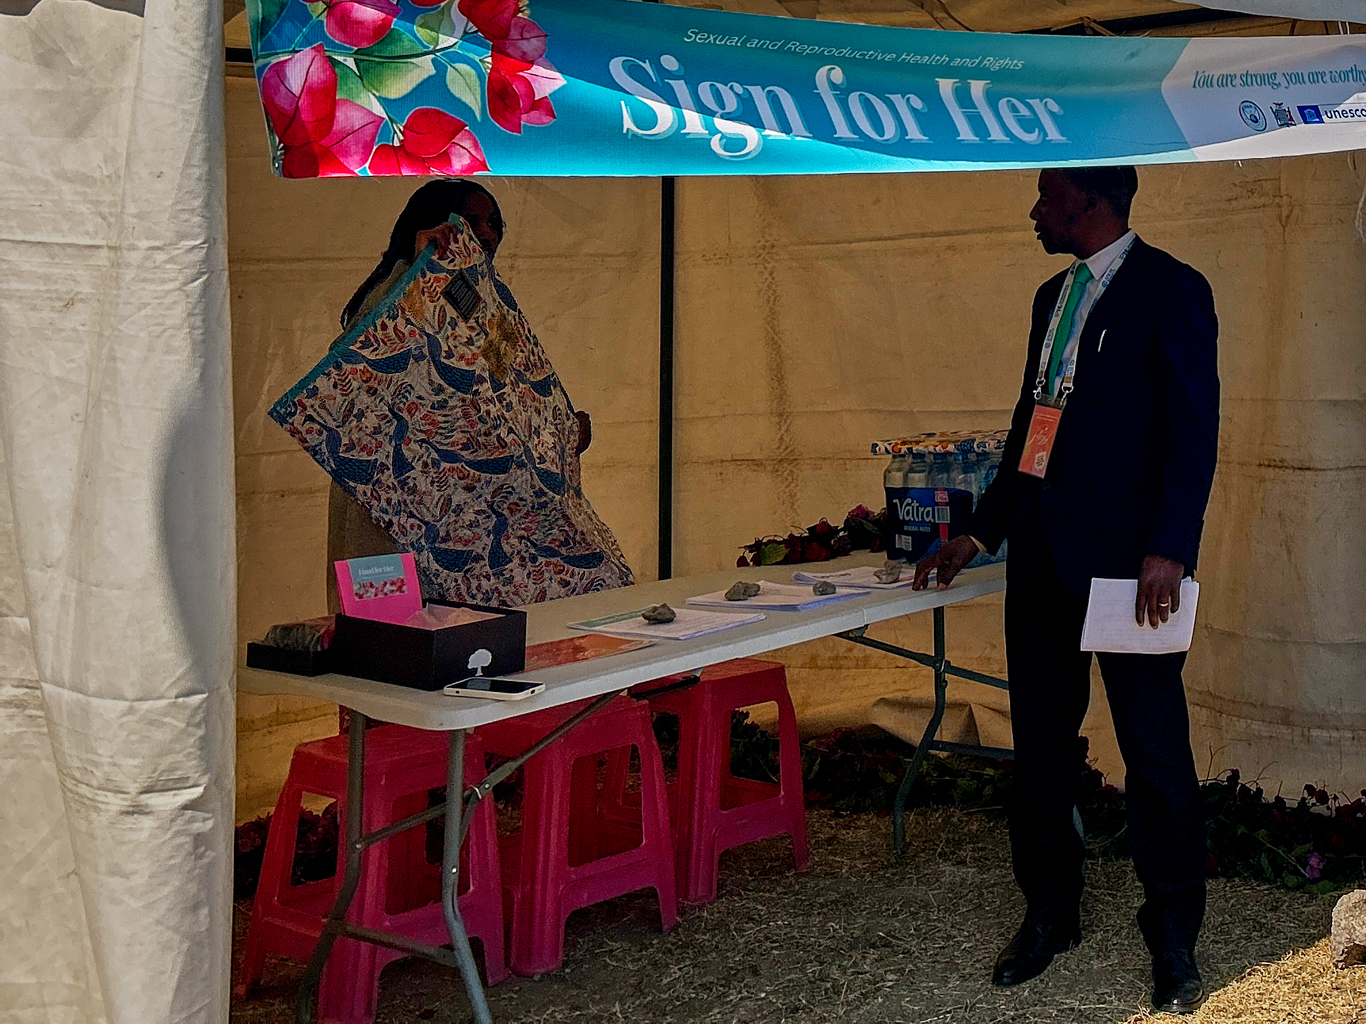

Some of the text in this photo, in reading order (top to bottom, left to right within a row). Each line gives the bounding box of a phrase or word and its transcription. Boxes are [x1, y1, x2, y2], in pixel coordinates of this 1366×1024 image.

[684, 29, 1025, 72] Sexual and Reproductive Health and Rights
[1192, 70, 1214, 88] You
[1216, 71, 1236, 87] are
[1239, 70, 1281, 90] strong,
[1284, 71, 1306, 89] you
[1307, 70, 1327, 85] are
[608, 54, 1070, 158] Sign for Her
[893, 498, 934, 522] Vatra
